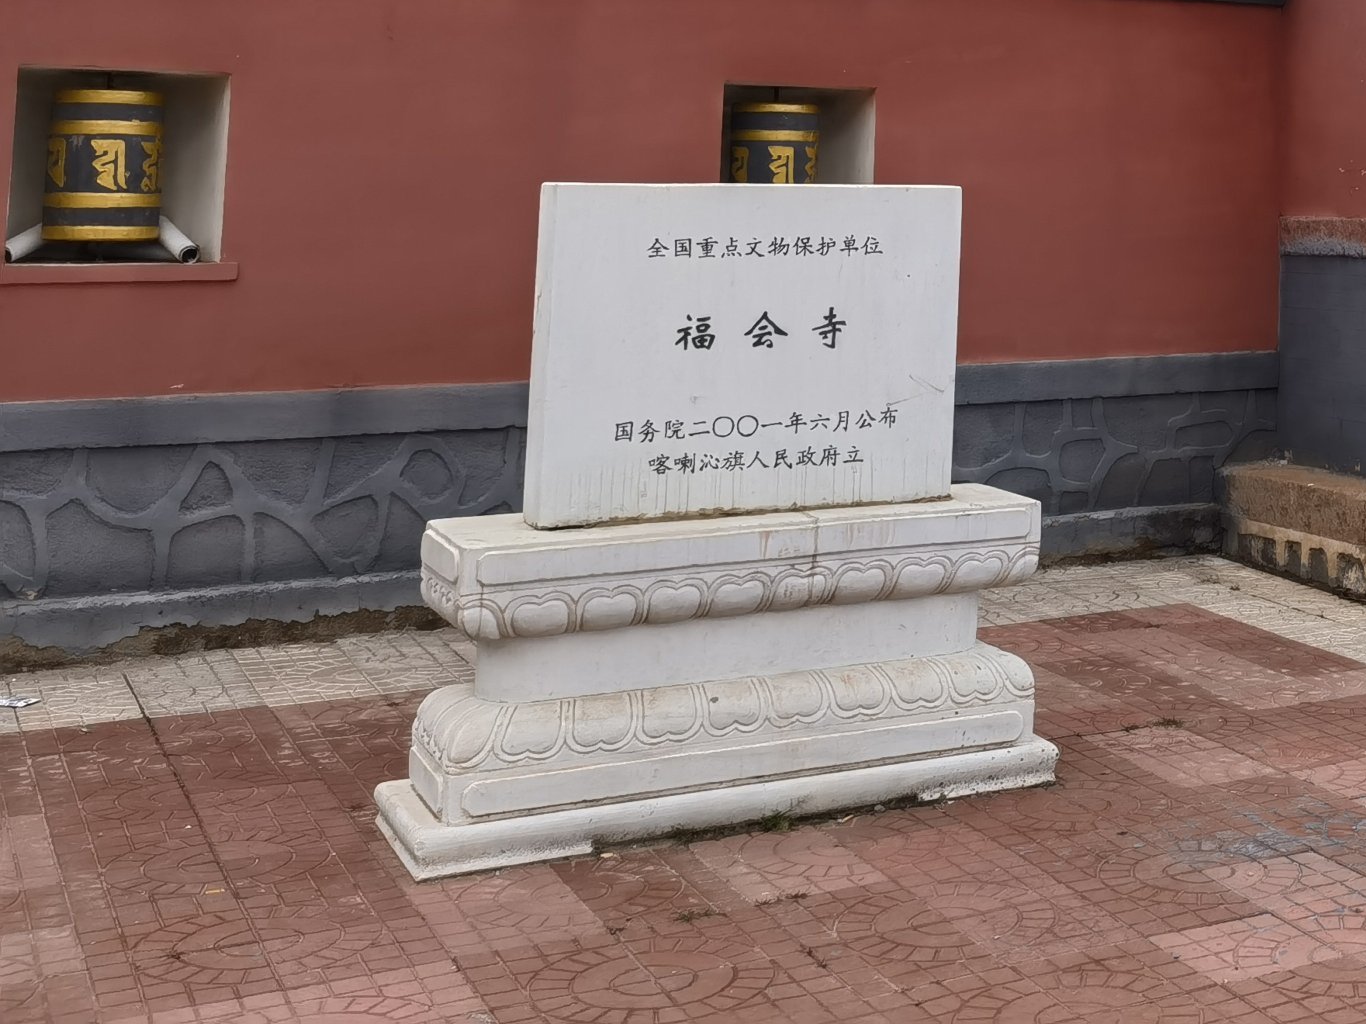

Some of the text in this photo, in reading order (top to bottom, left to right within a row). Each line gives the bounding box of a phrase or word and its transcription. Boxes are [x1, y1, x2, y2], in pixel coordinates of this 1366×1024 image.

[648, 235, 882, 258] 全国重点文物保护单位
[675, 307, 846, 350] 福会寺
[615, 407, 897, 442] 国务院二〇〇一年六月公布
[649, 445, 863, 474] 喀喇沁旗人民政府立
